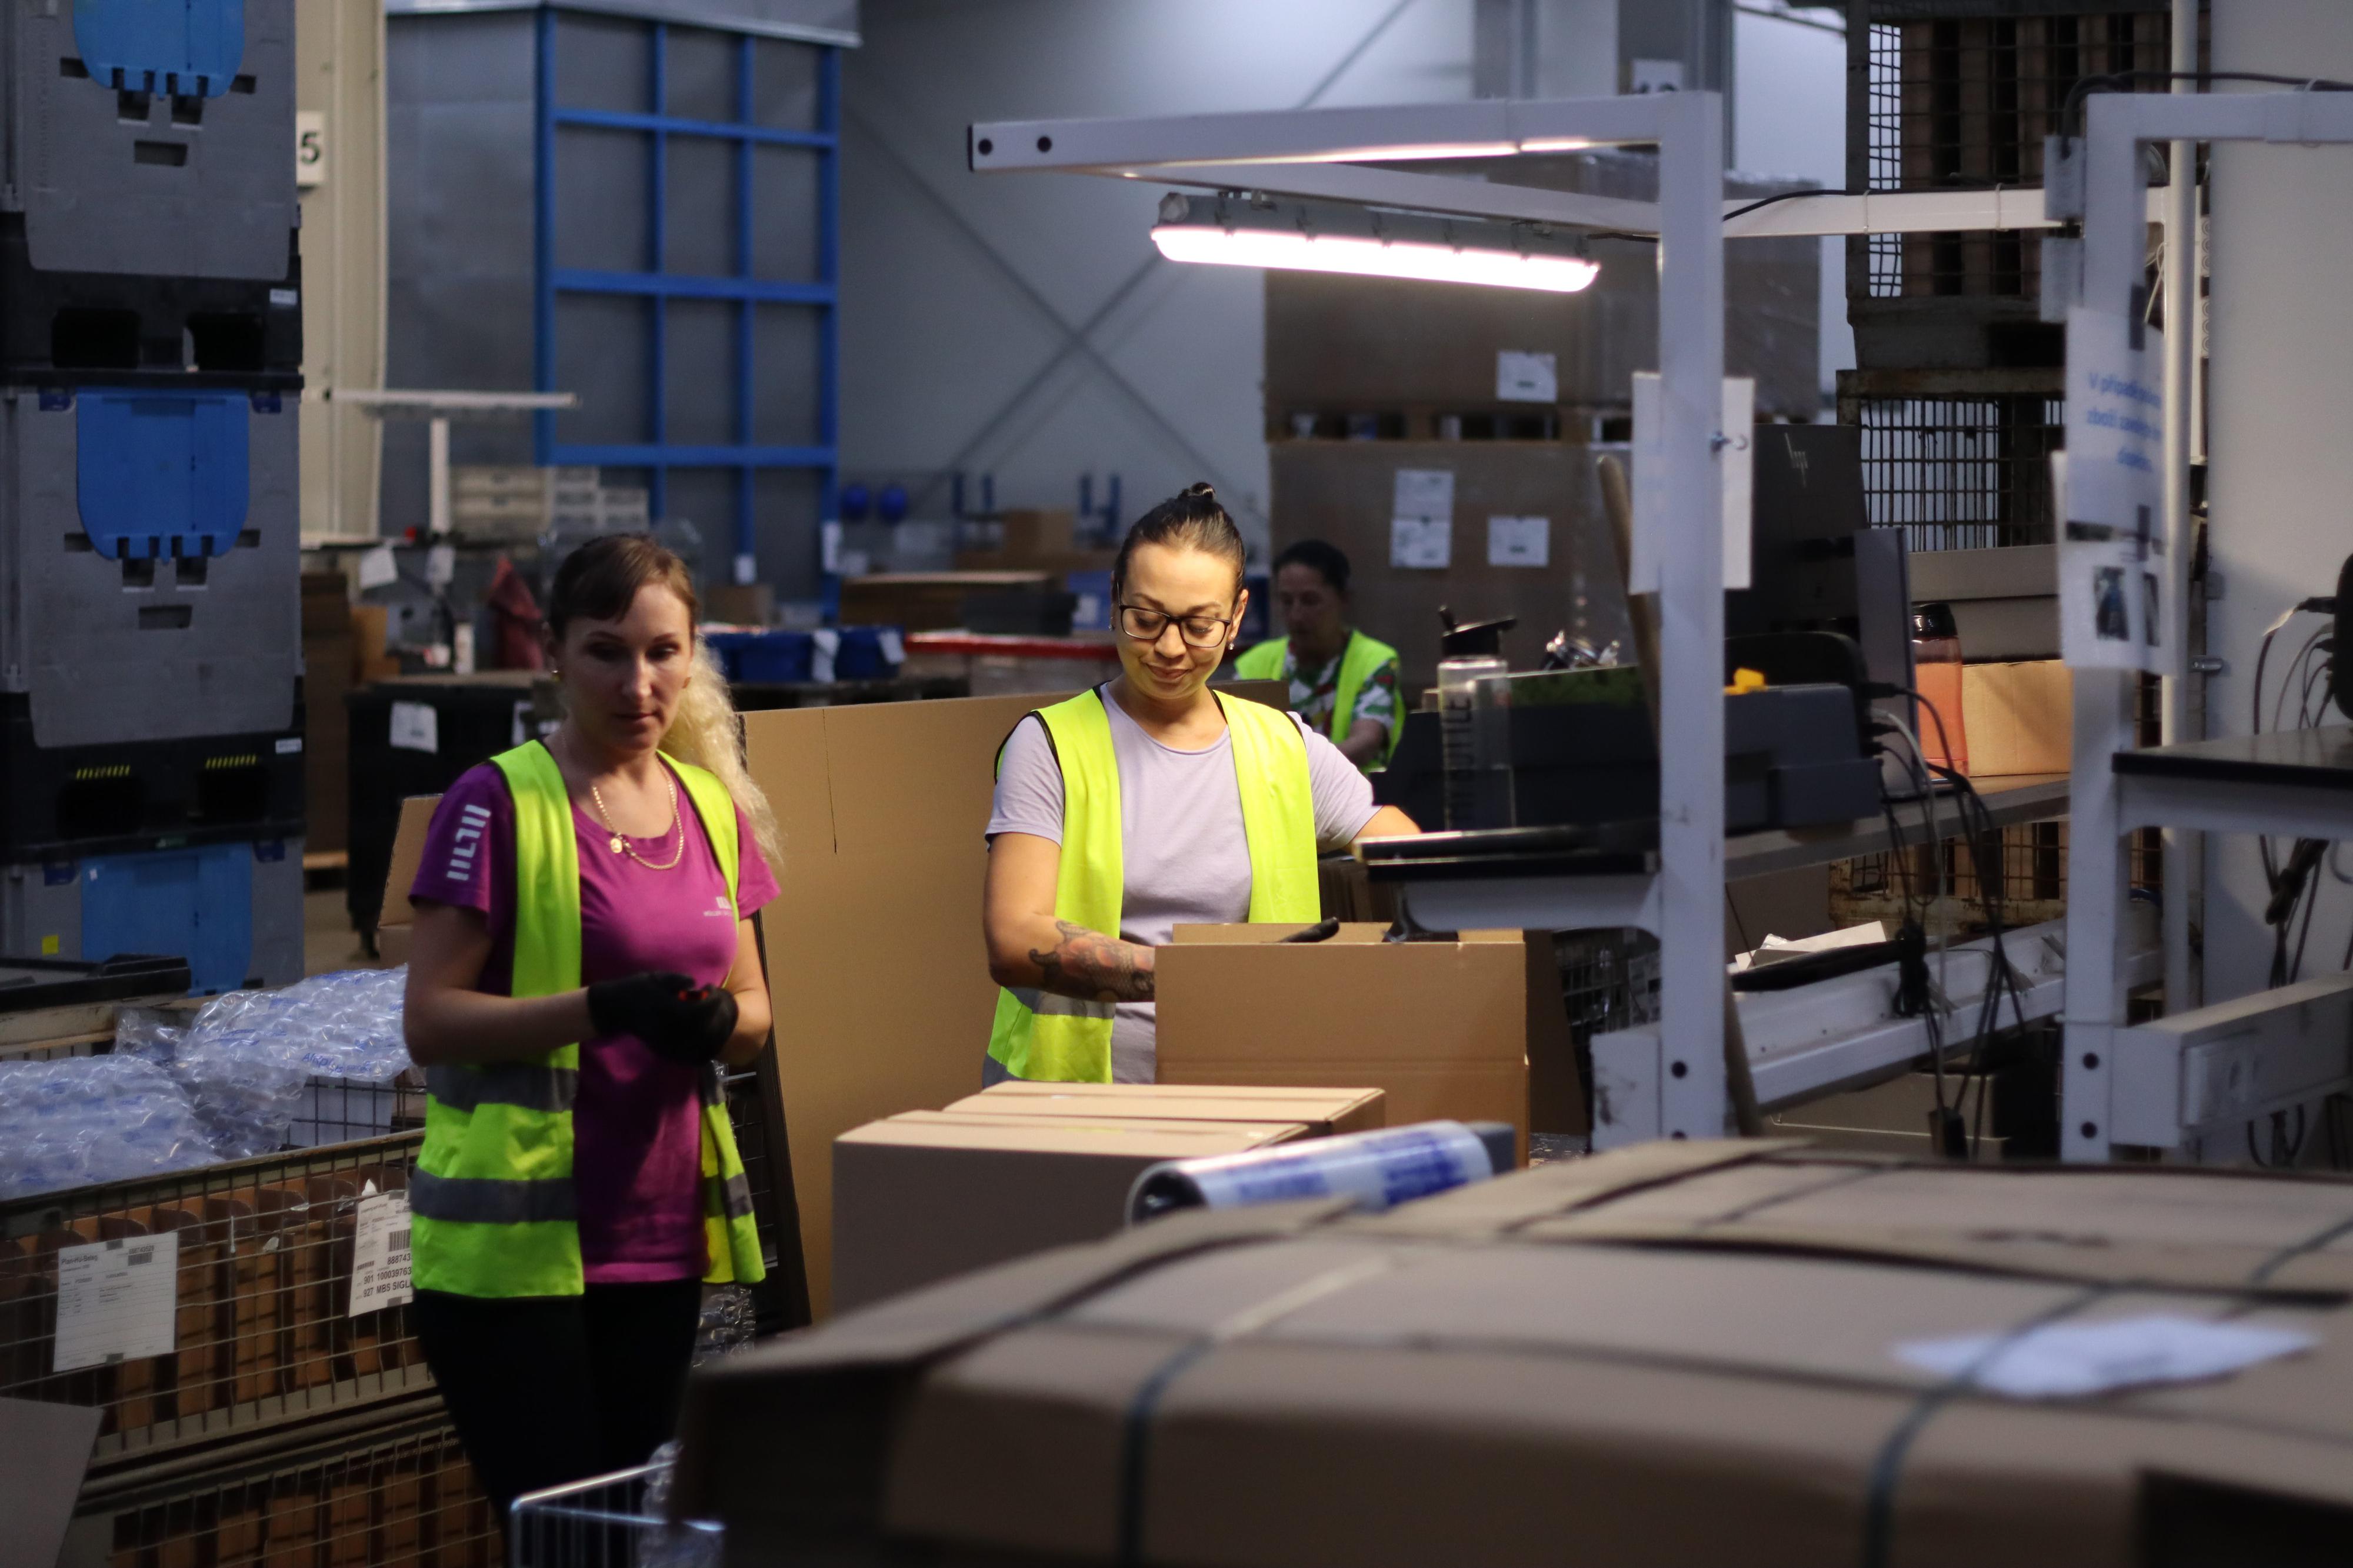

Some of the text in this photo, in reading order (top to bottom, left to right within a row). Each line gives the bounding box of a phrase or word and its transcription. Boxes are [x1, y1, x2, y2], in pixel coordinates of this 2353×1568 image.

[301, 131, 321, 165] 5
[364, 1275, 374, 1285] 901
[376, 1283, 391, 1295] MBS
